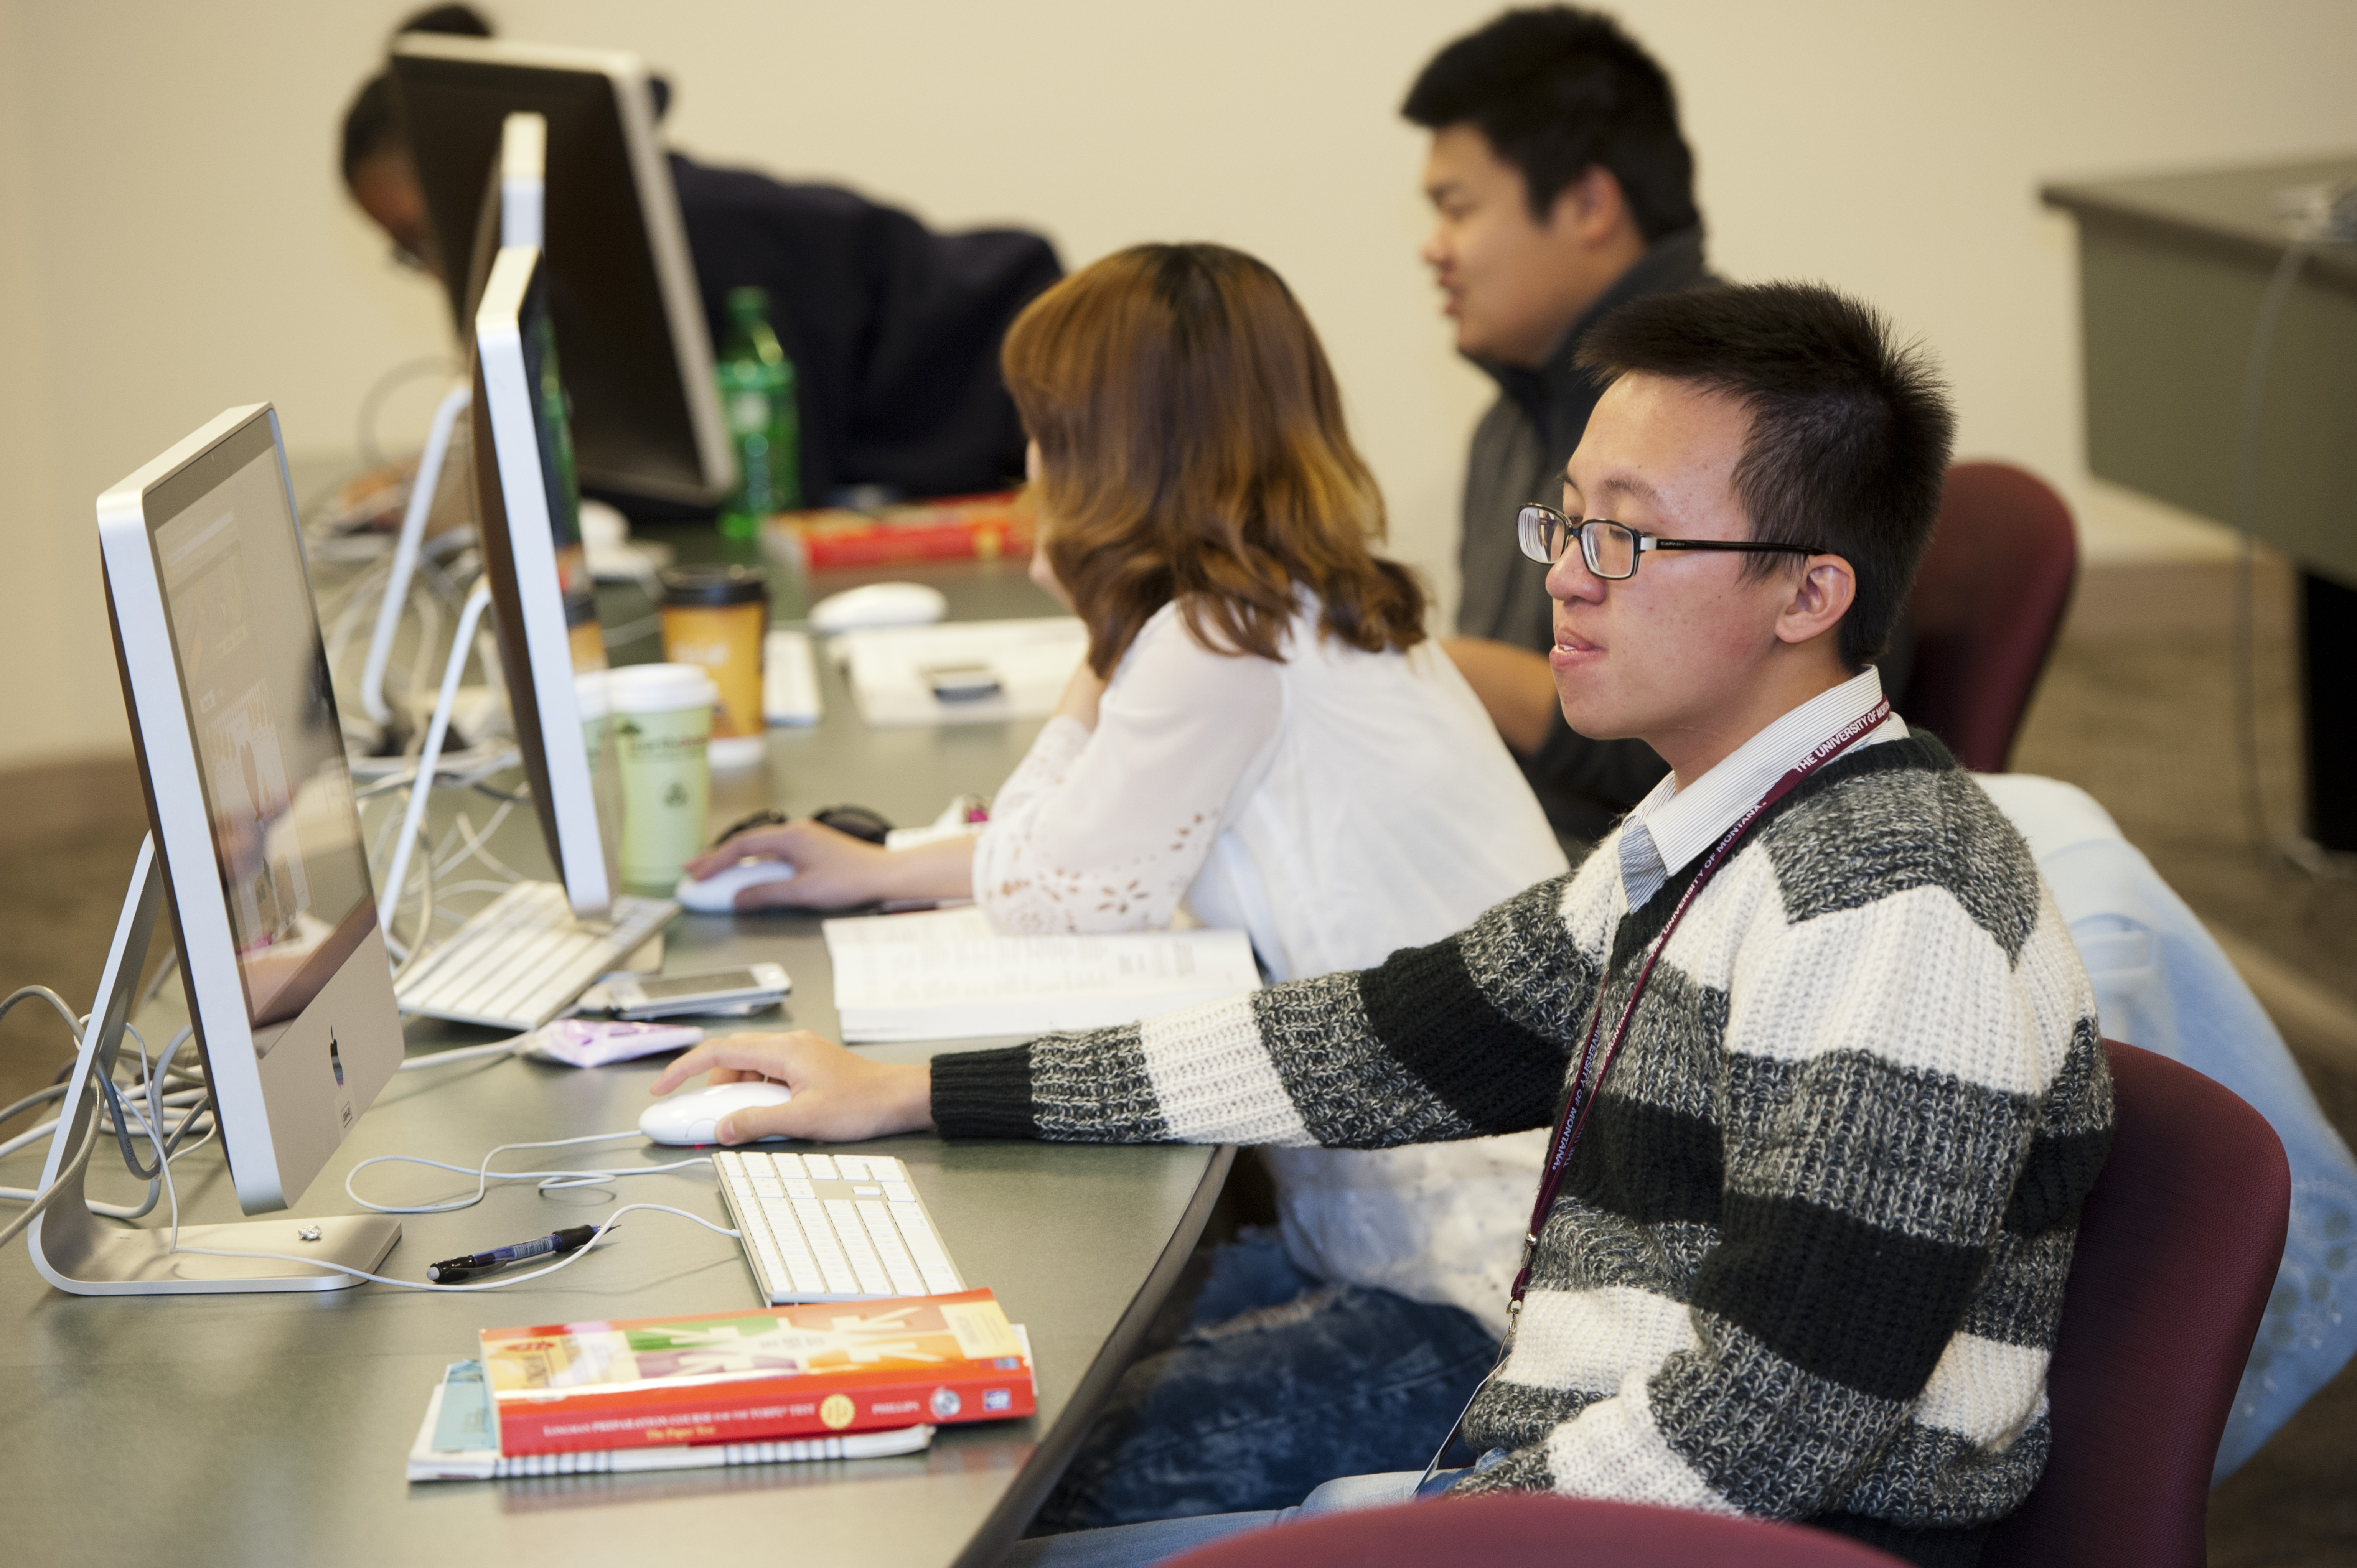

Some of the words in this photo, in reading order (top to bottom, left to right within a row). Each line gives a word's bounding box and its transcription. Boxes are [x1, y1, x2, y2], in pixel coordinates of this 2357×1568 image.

[1793, 754, 1818, 773] THE
[1815, 716, 1868, 758] UNIVERSITY
[1867, 710, 1876, 723] OF
[1663, 869, 1704, 934] UNIVERSITY
[1704, 852, 1716, 869] OF
[1575, 1089, 1582, 1107] OF
